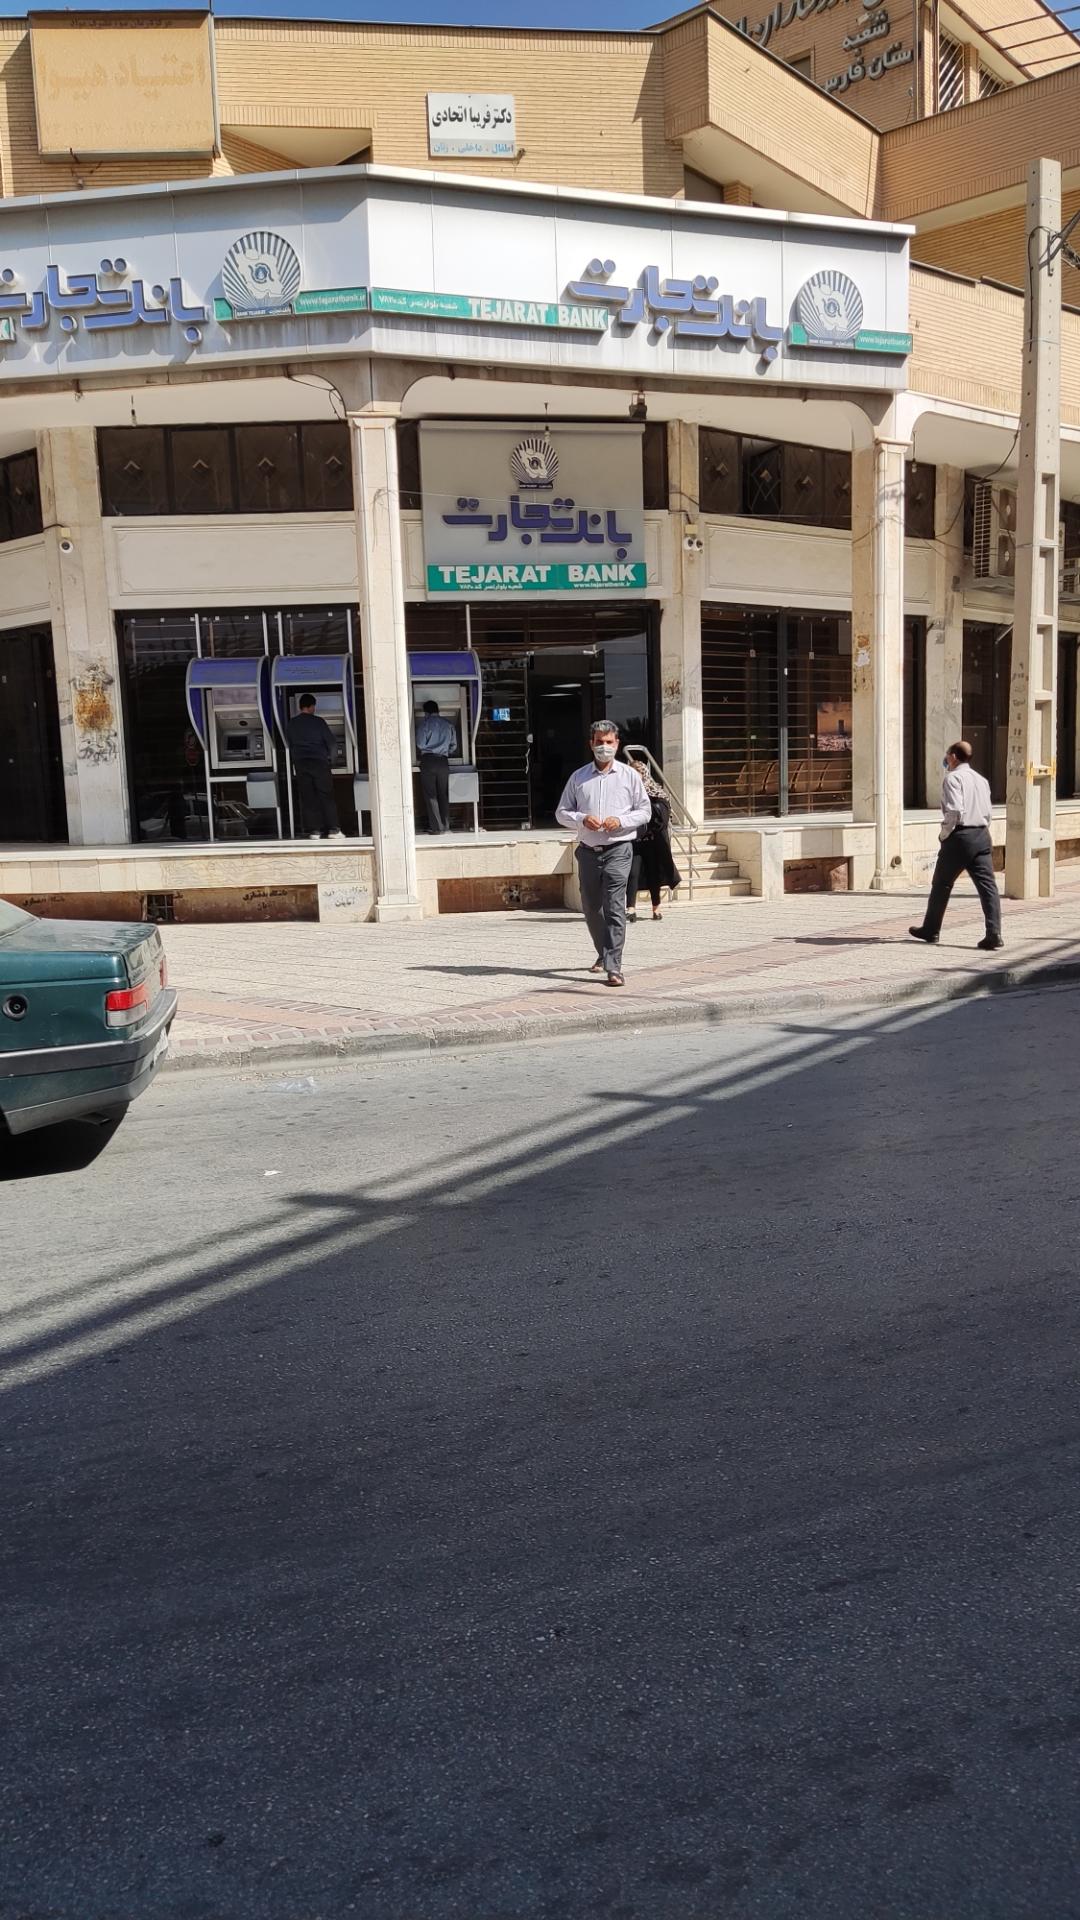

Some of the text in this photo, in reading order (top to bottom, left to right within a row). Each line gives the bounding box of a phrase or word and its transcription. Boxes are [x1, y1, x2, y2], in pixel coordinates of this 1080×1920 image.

[432, 104, 512, 129] دکتر فریبا اتحادی
[83, 278, 210, 344] بانک
[468, 298, 607, 329] TEJARAT BANK
[566, 258, 784, 362] بانک تجارت
[442, 495, 633, 561] بانک تجارت
[439, 564, 636, 584] TEJARAT BANK
